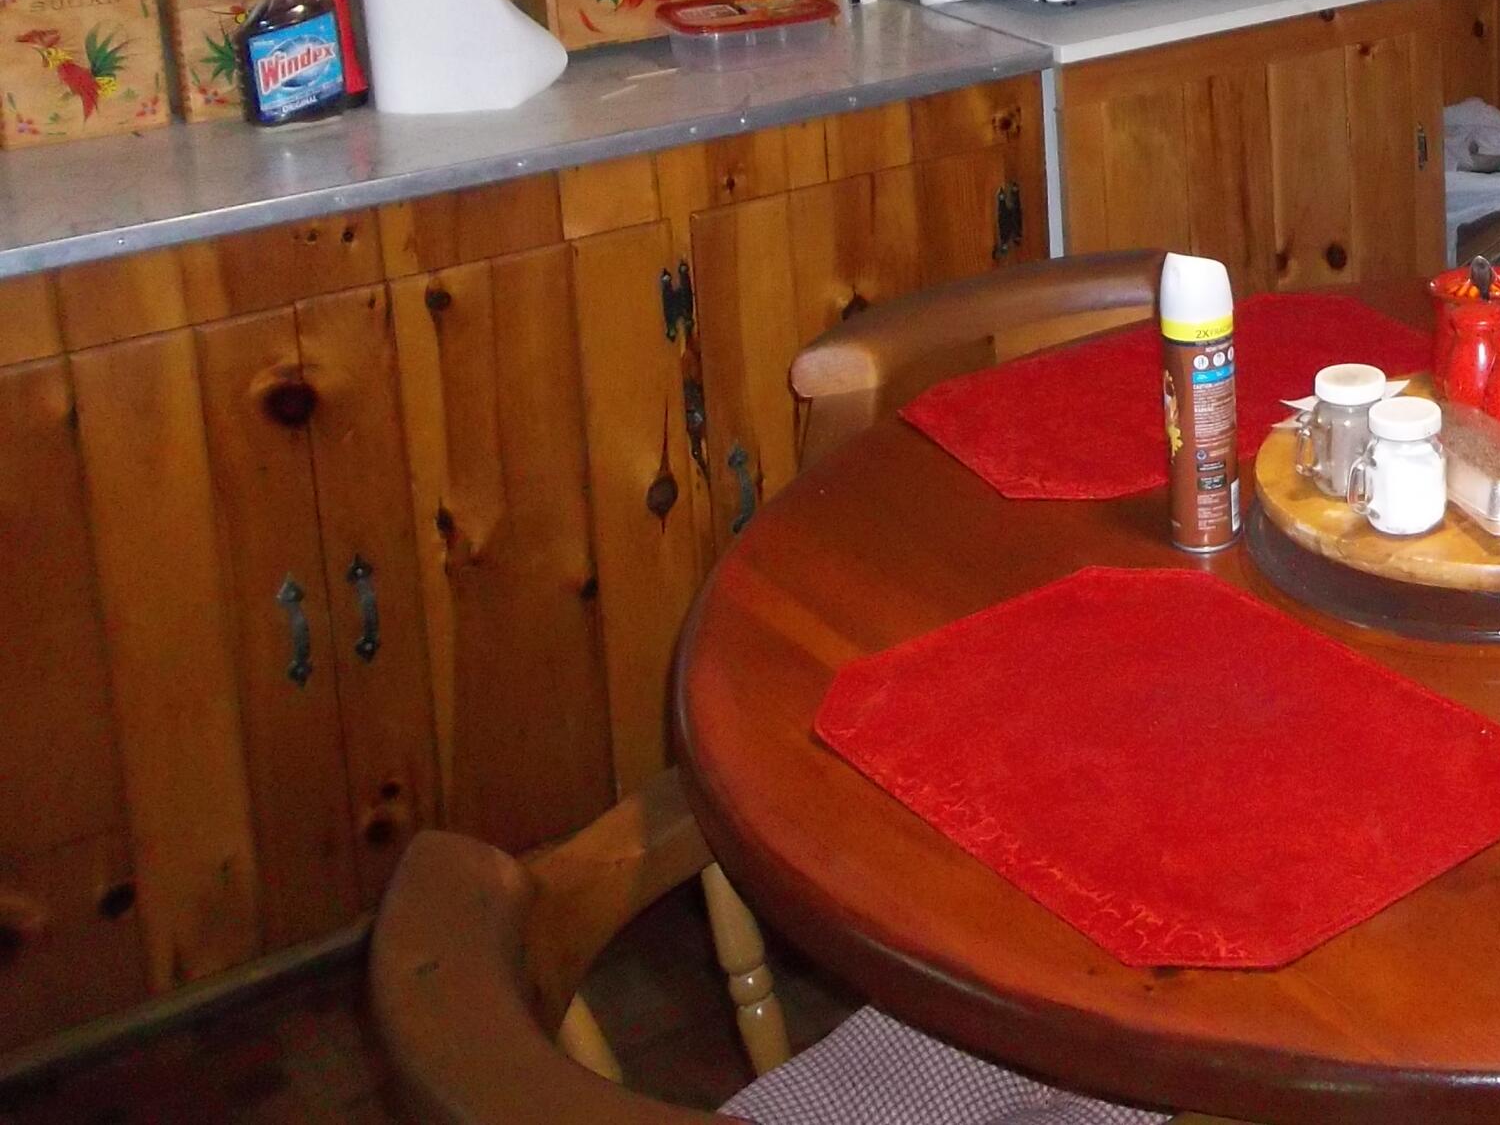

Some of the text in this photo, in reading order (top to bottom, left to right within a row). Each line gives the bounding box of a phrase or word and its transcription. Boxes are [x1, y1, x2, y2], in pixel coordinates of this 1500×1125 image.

[258, 45, 337, 95] Windex
[281, 95, 318, 114] ORIGINAL
[1195, 328, 1210, 339] 2X
